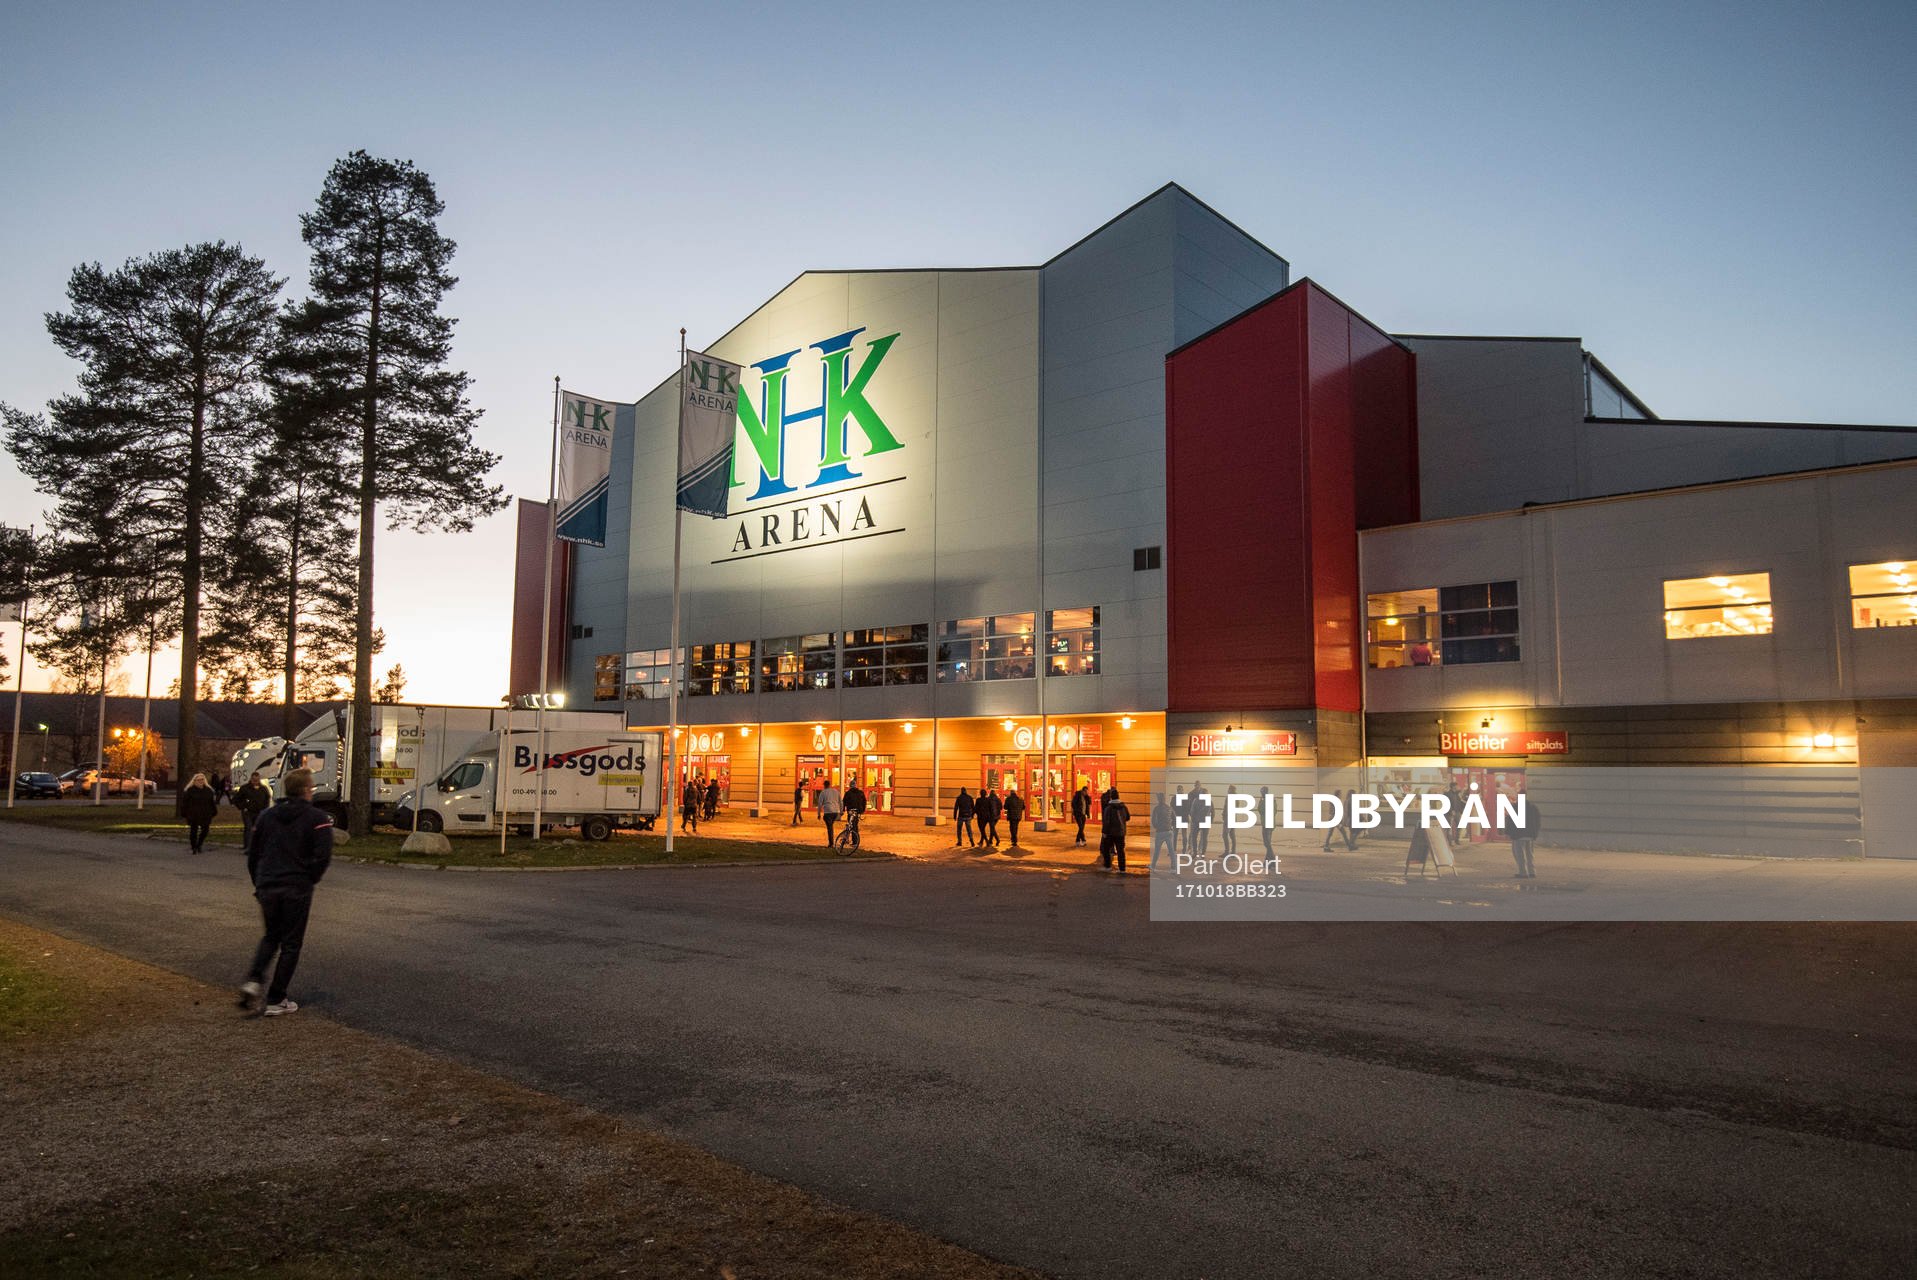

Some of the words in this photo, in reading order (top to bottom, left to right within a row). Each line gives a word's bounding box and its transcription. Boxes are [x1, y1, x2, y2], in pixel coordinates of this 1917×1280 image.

[690, 359, 737, 395] NHK
[565, 399, 611, 432] NHK
[689, 392, 734, 413] ARENA
[729, 326, 906, 502] NHK
[566, 430, 608, 449] ARENA
[731, 495, 877, 553] ARENA
[1191, 735, 1245, 755] Biljetter
[1441, 732, 1509, 754] Biljetter
[1526, 738, 1564, 753] sittplats
[514, 745, 647, 777] Bussgods
